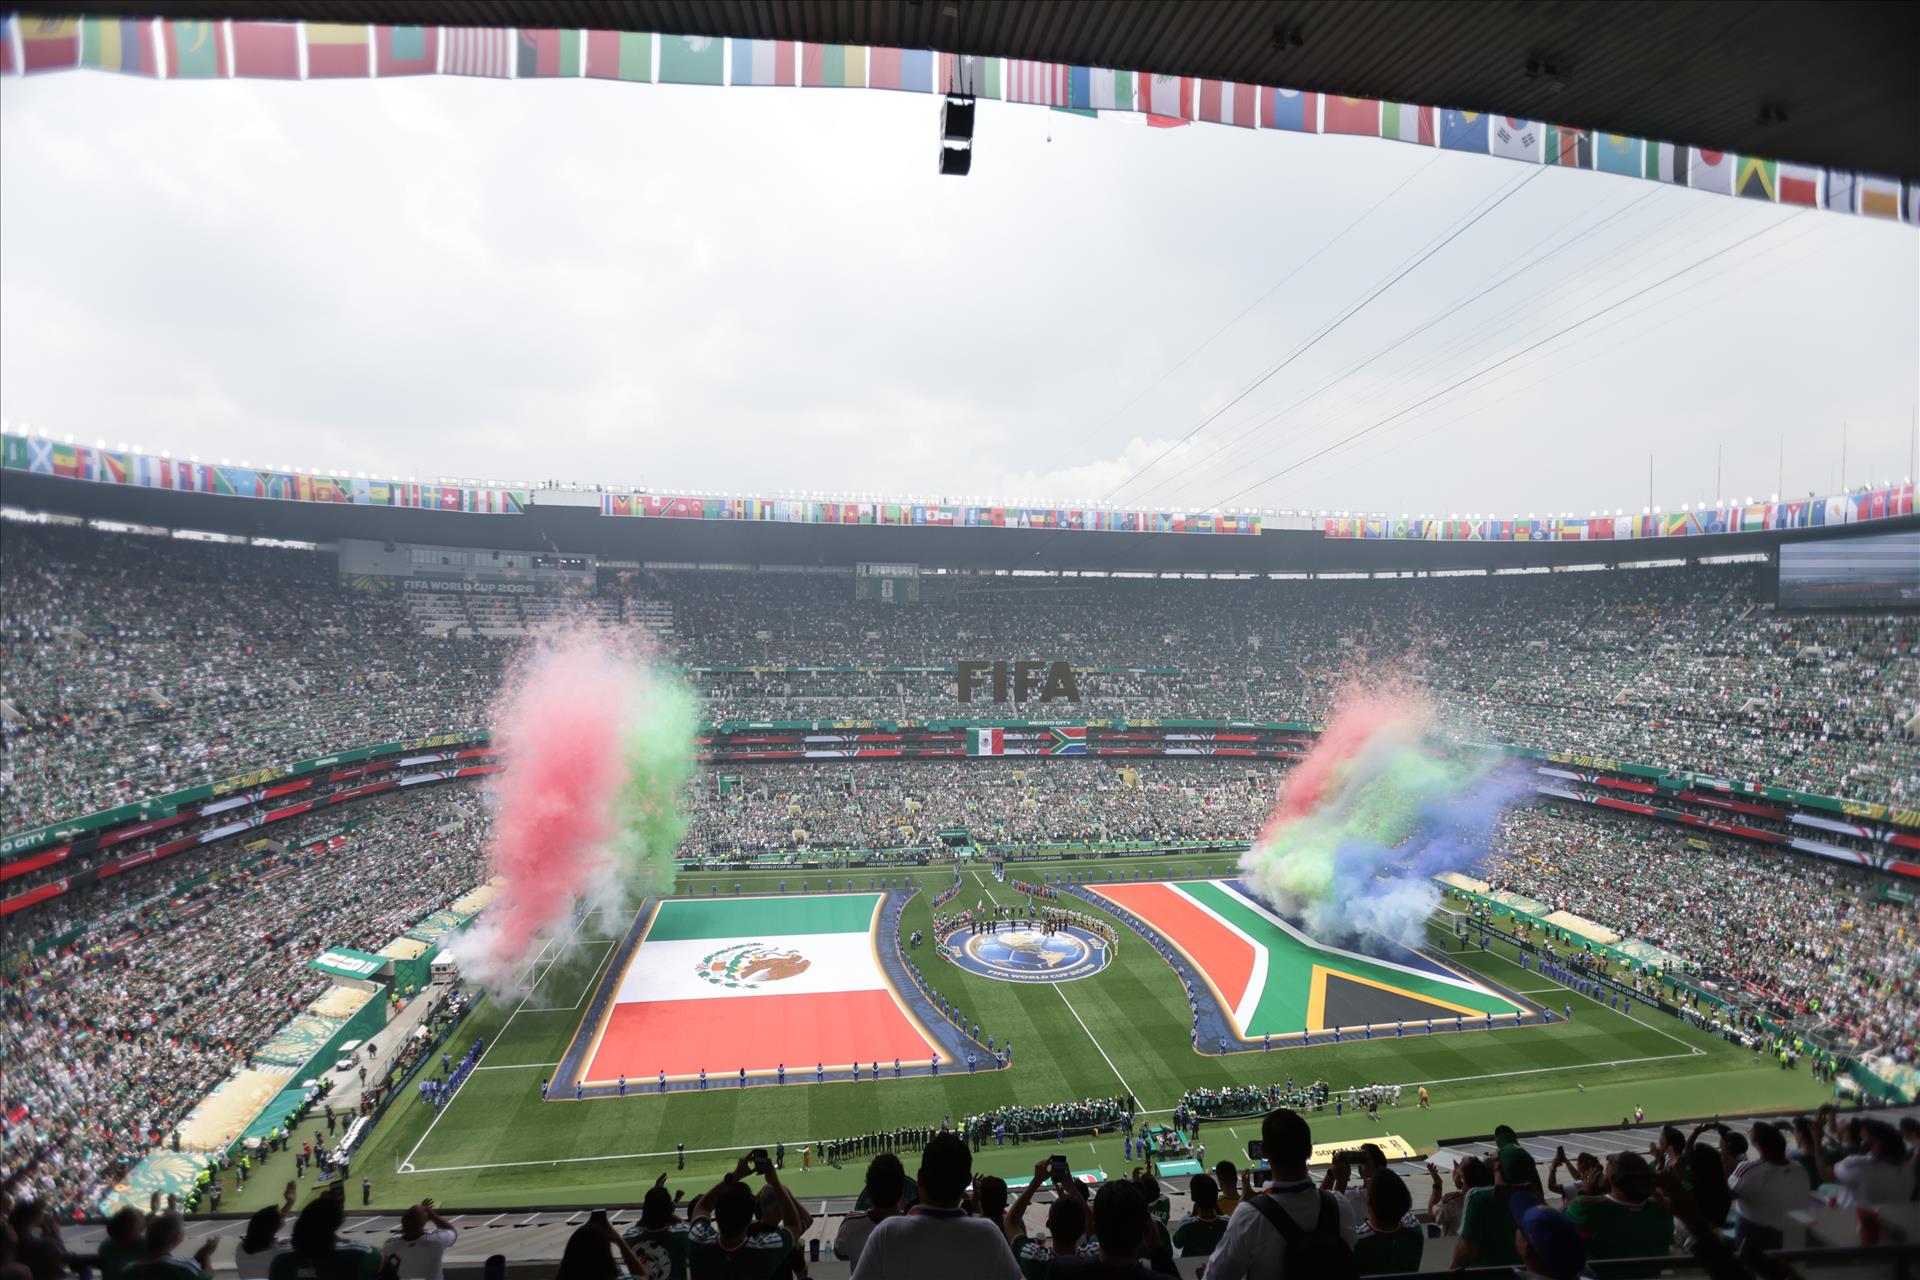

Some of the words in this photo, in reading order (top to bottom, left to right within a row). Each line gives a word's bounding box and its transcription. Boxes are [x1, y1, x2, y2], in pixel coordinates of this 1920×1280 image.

[404, 580, 428, 590] FIFA
[430, 581, 472, 591] WORLD
[474, 582, 495, 592] CUP
[497, 584, 535, 593] 2026
[958, 661, 1080, 702] FIFA
[15, 832, 46, 848] CITY
[1586, 972, 1599, 981] FIFA
[1600, 977, 1622, 991] WORLD
[1622, 987, 1635, 996] CUP
[1636, 993, 1659, 1008] 2026
